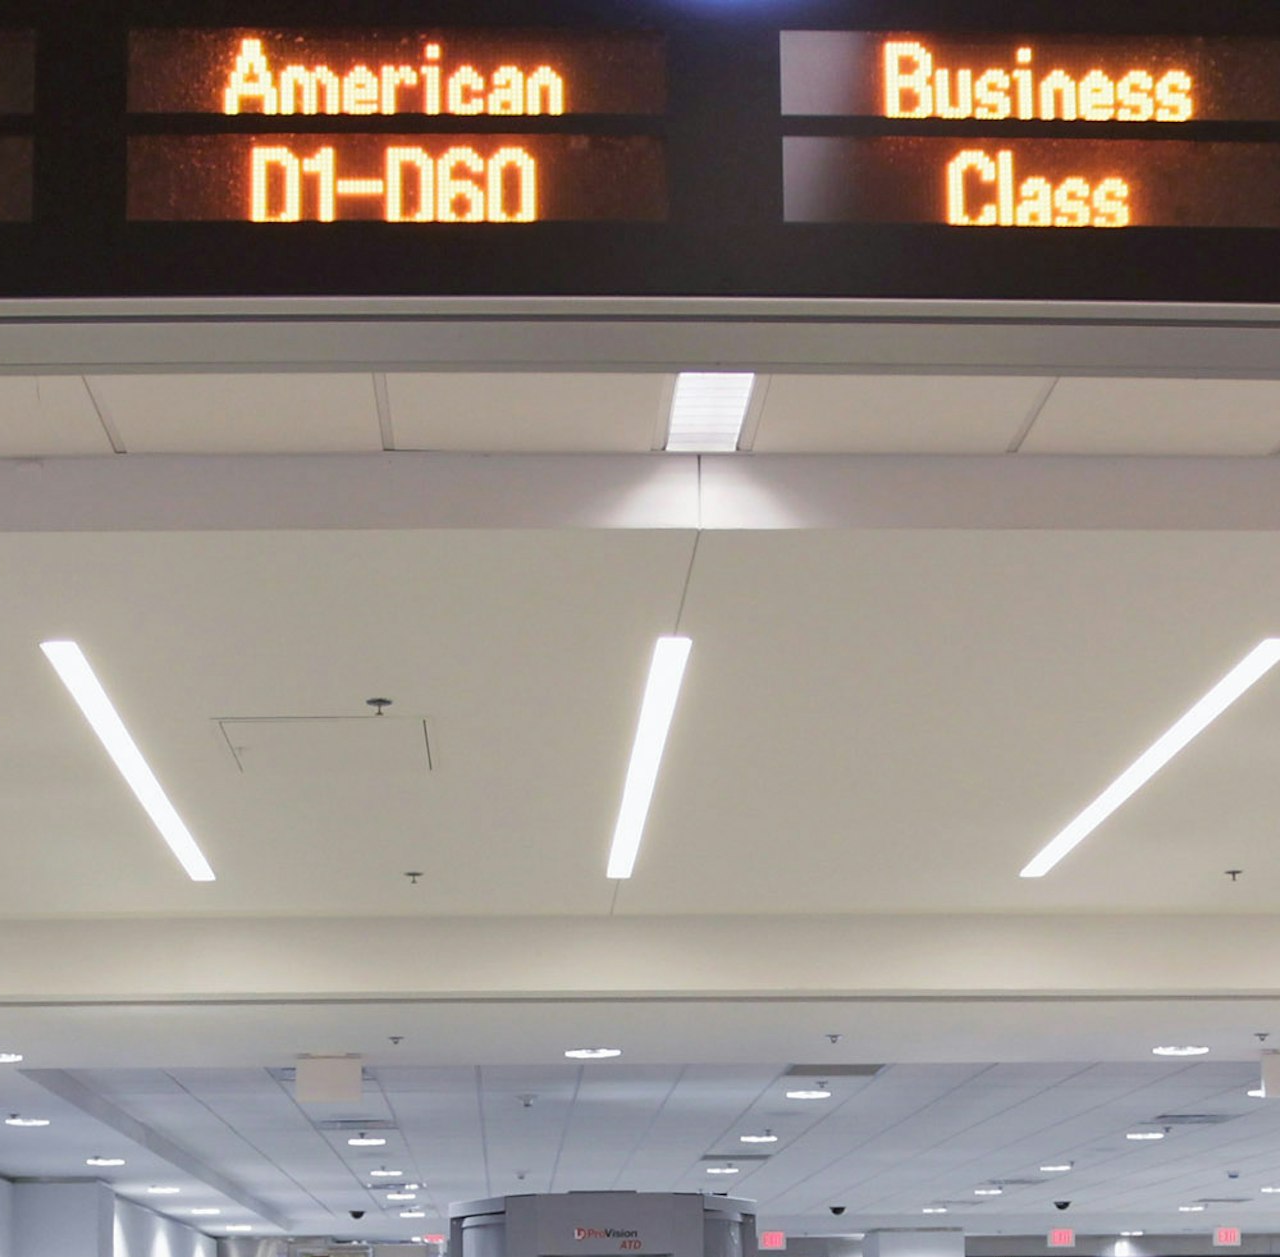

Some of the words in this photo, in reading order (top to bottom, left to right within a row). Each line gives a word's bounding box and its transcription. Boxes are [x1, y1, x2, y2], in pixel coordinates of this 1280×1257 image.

[219, 36, 566, 115] American
[877, 38, 1198, 122] Business
[245, 141, 538, 224] D1-D60
[943, 147, 1138, 229] Class
[588, 1228, 637, 1239] ProVision
[621, 1240, 642, 1250] ATD
